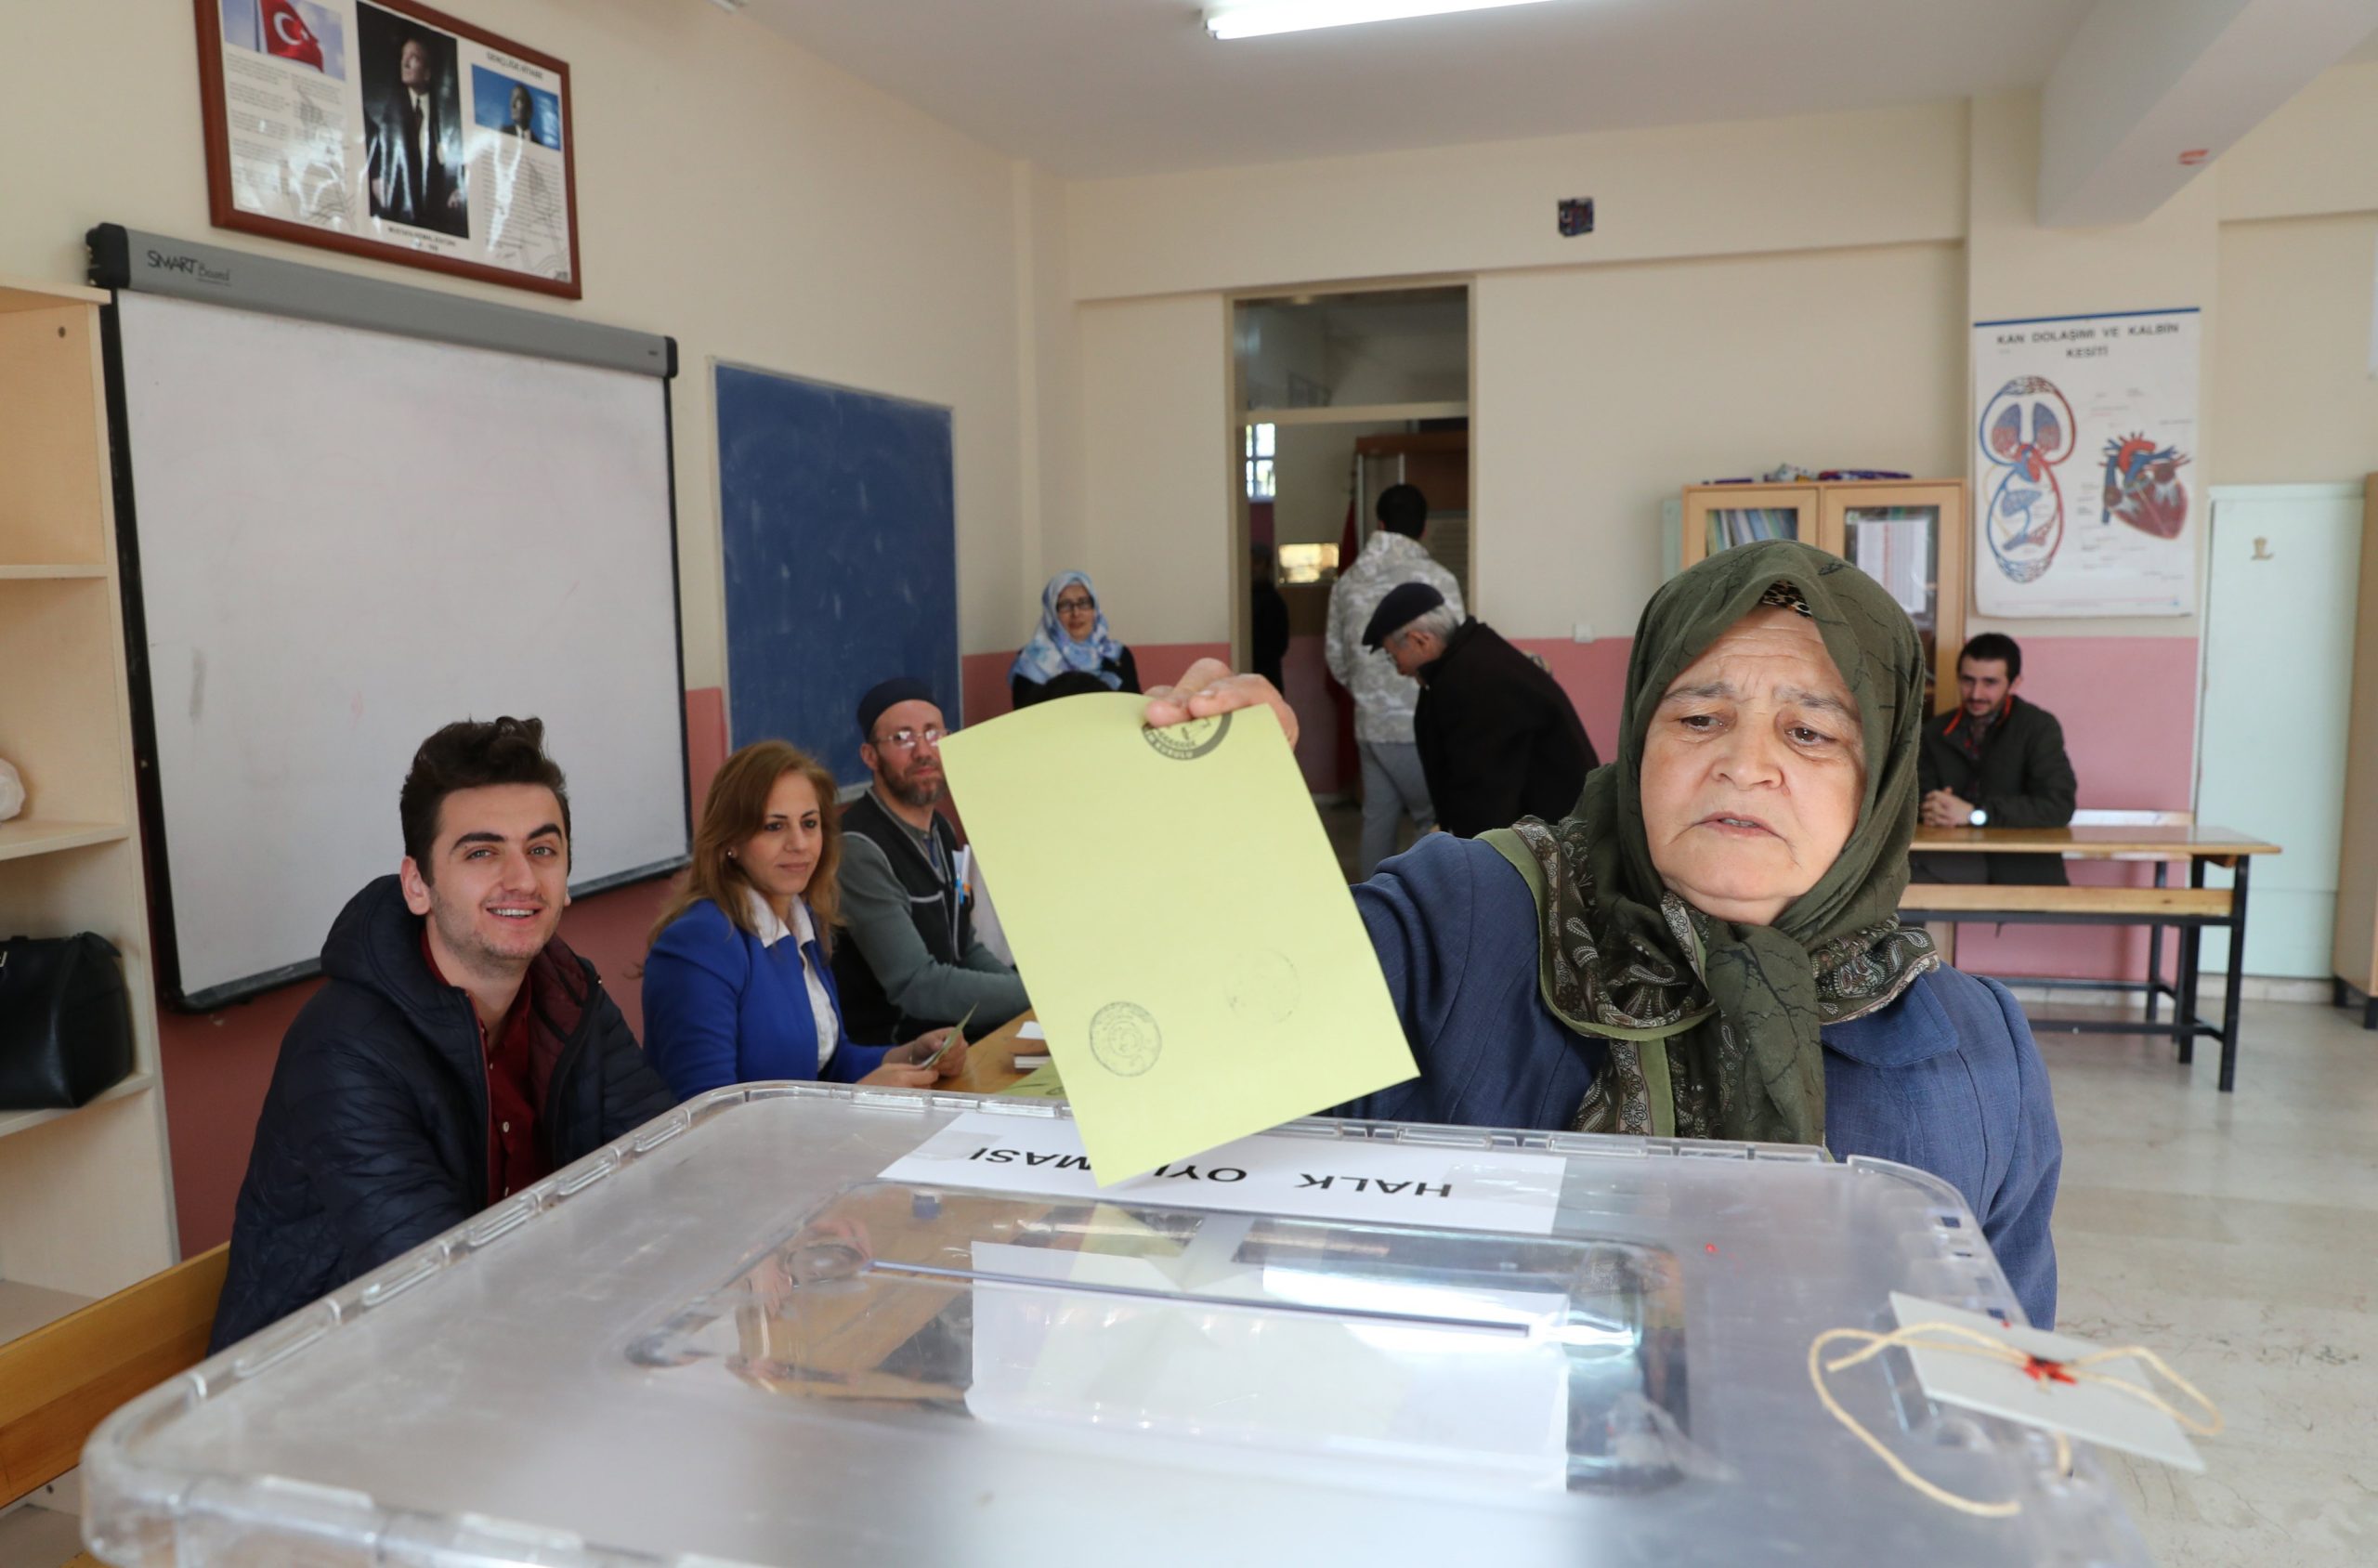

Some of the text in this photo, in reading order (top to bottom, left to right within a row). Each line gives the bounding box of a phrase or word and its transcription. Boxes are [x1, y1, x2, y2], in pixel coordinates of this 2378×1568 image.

[147, 249, 198, 274] SMART
[1996, 333, 2025, 345] KAN
[2102, 327, 2119, 338] VE
[1295, 1173, 1452, 1197] HALK
